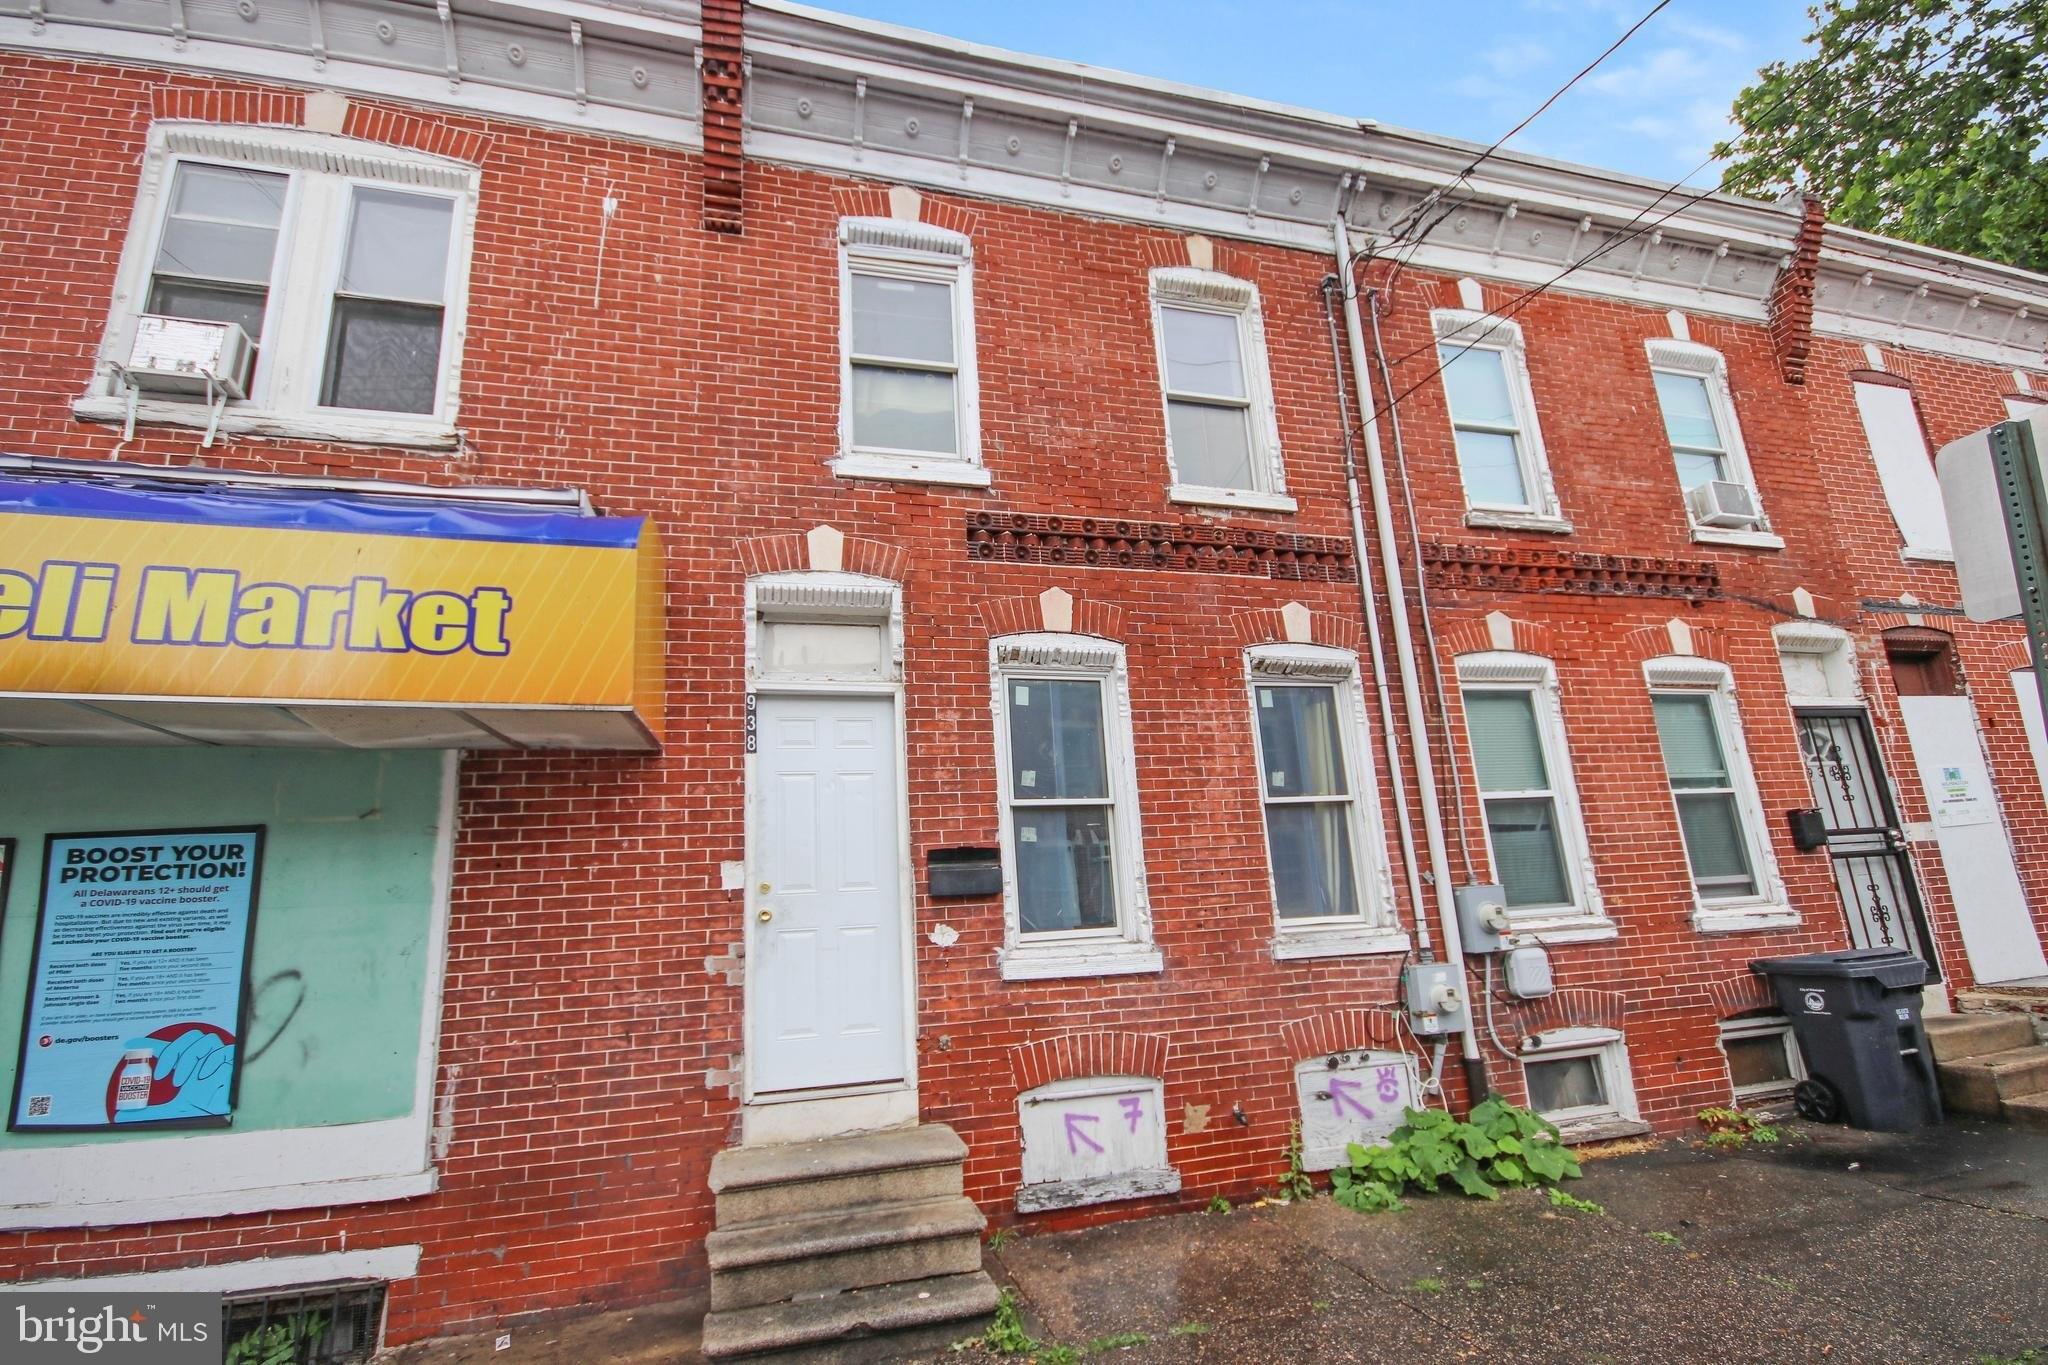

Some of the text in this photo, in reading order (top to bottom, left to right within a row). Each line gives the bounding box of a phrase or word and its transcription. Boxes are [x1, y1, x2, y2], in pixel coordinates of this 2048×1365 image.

[131, 565, 512, 657] Market
[747, 694, 756, 751] 938
[67, 844, 245, 865] BOOST YOUR
[60, 862, 246, 884] PROTECTION!
[90, 888, 155, 897] Delawareans
[178, 885, 211, 893] should
[213, 885, 229, 895] get
[90, 898, 136, 907] COVID-19
[140, 896, 177, 905] vaccine
[179, 895, 220, 903] booster.
[55, 1034, 119, 1045] de.gov/boosters
[122, 1076, 150, 1085] COVID-19
[119, 1091, 148, 1100] BOOSTER
[1118, 1097, 1144, 1135] 7
